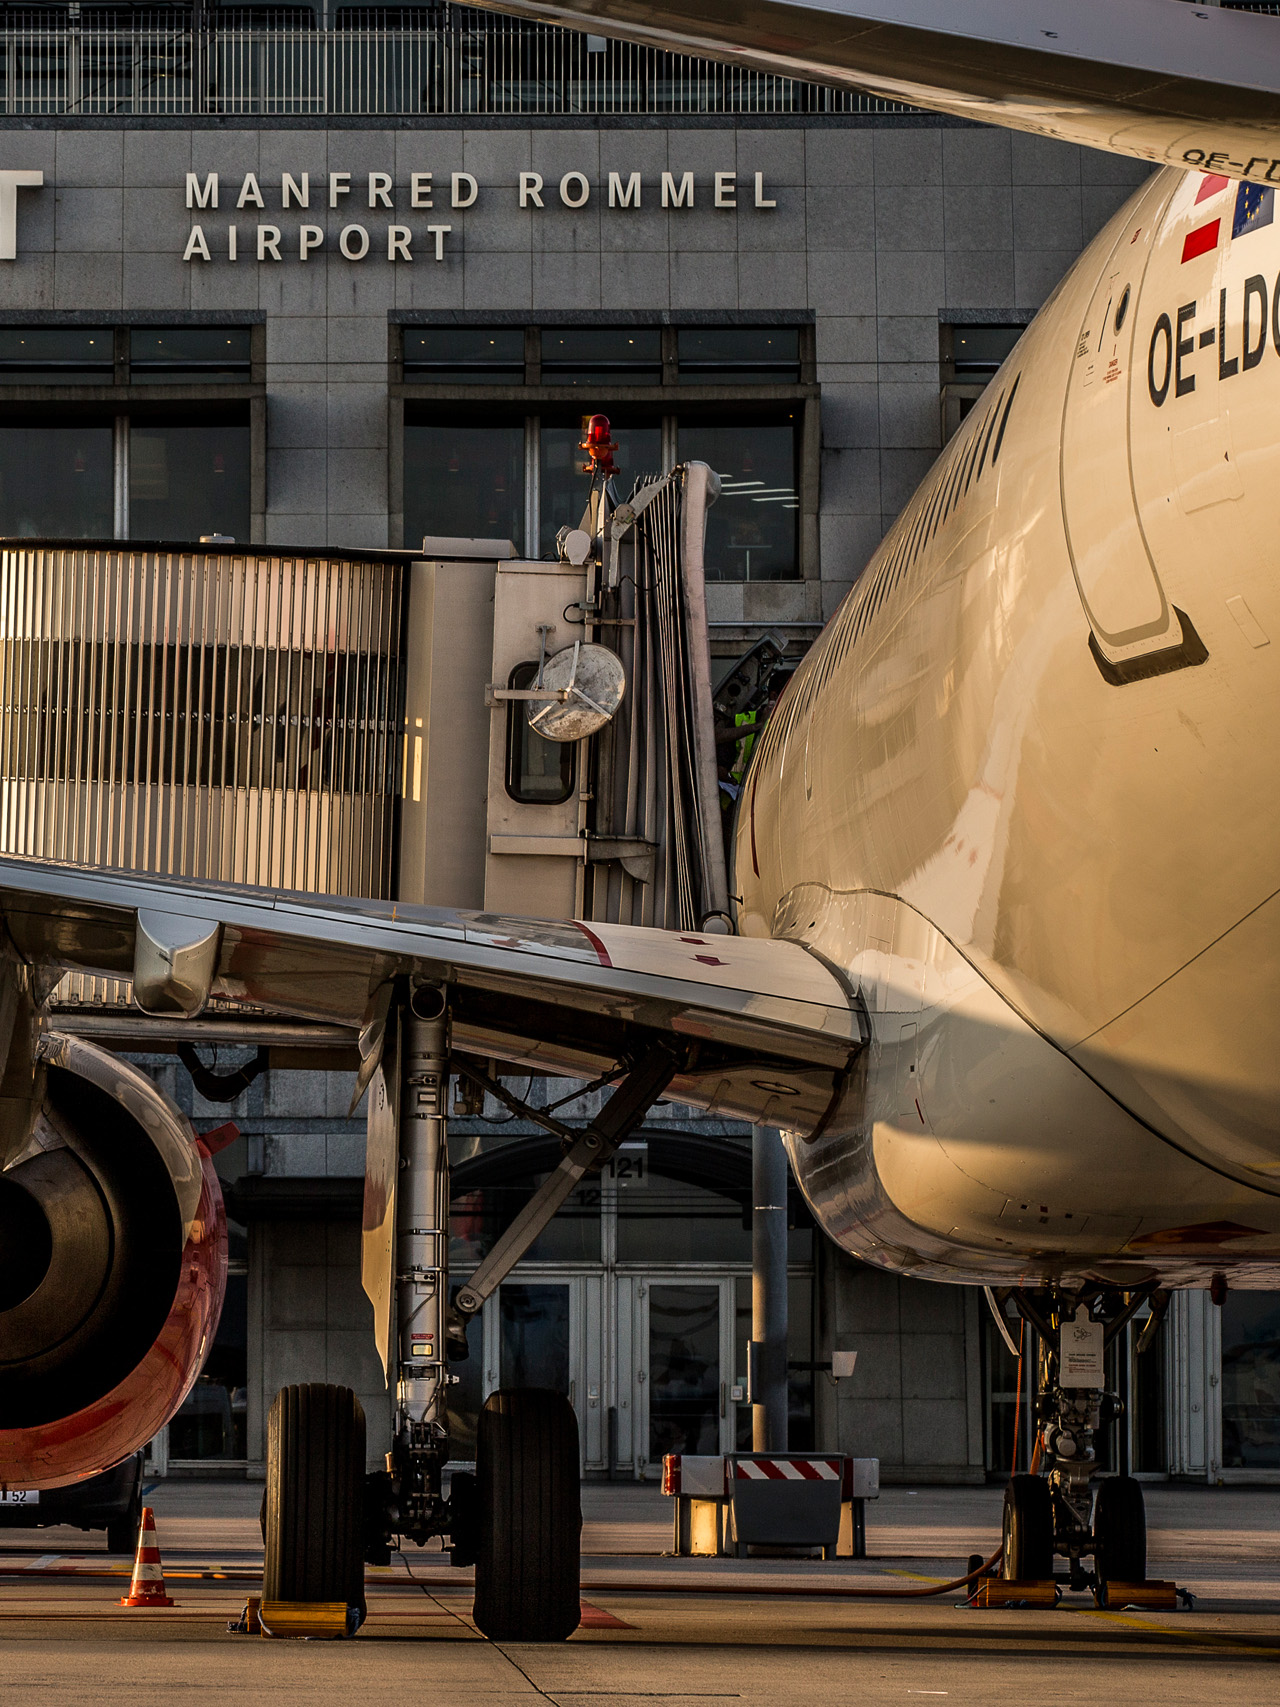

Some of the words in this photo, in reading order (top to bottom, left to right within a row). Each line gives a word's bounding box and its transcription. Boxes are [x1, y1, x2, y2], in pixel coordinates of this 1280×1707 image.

[185, 171, 479, 209] MANFRED
[519, 171, 777, 208] ROMMEL
[182, 223, 453, 262] AIRPORT
[607, 1157, 643, 1178] 121
